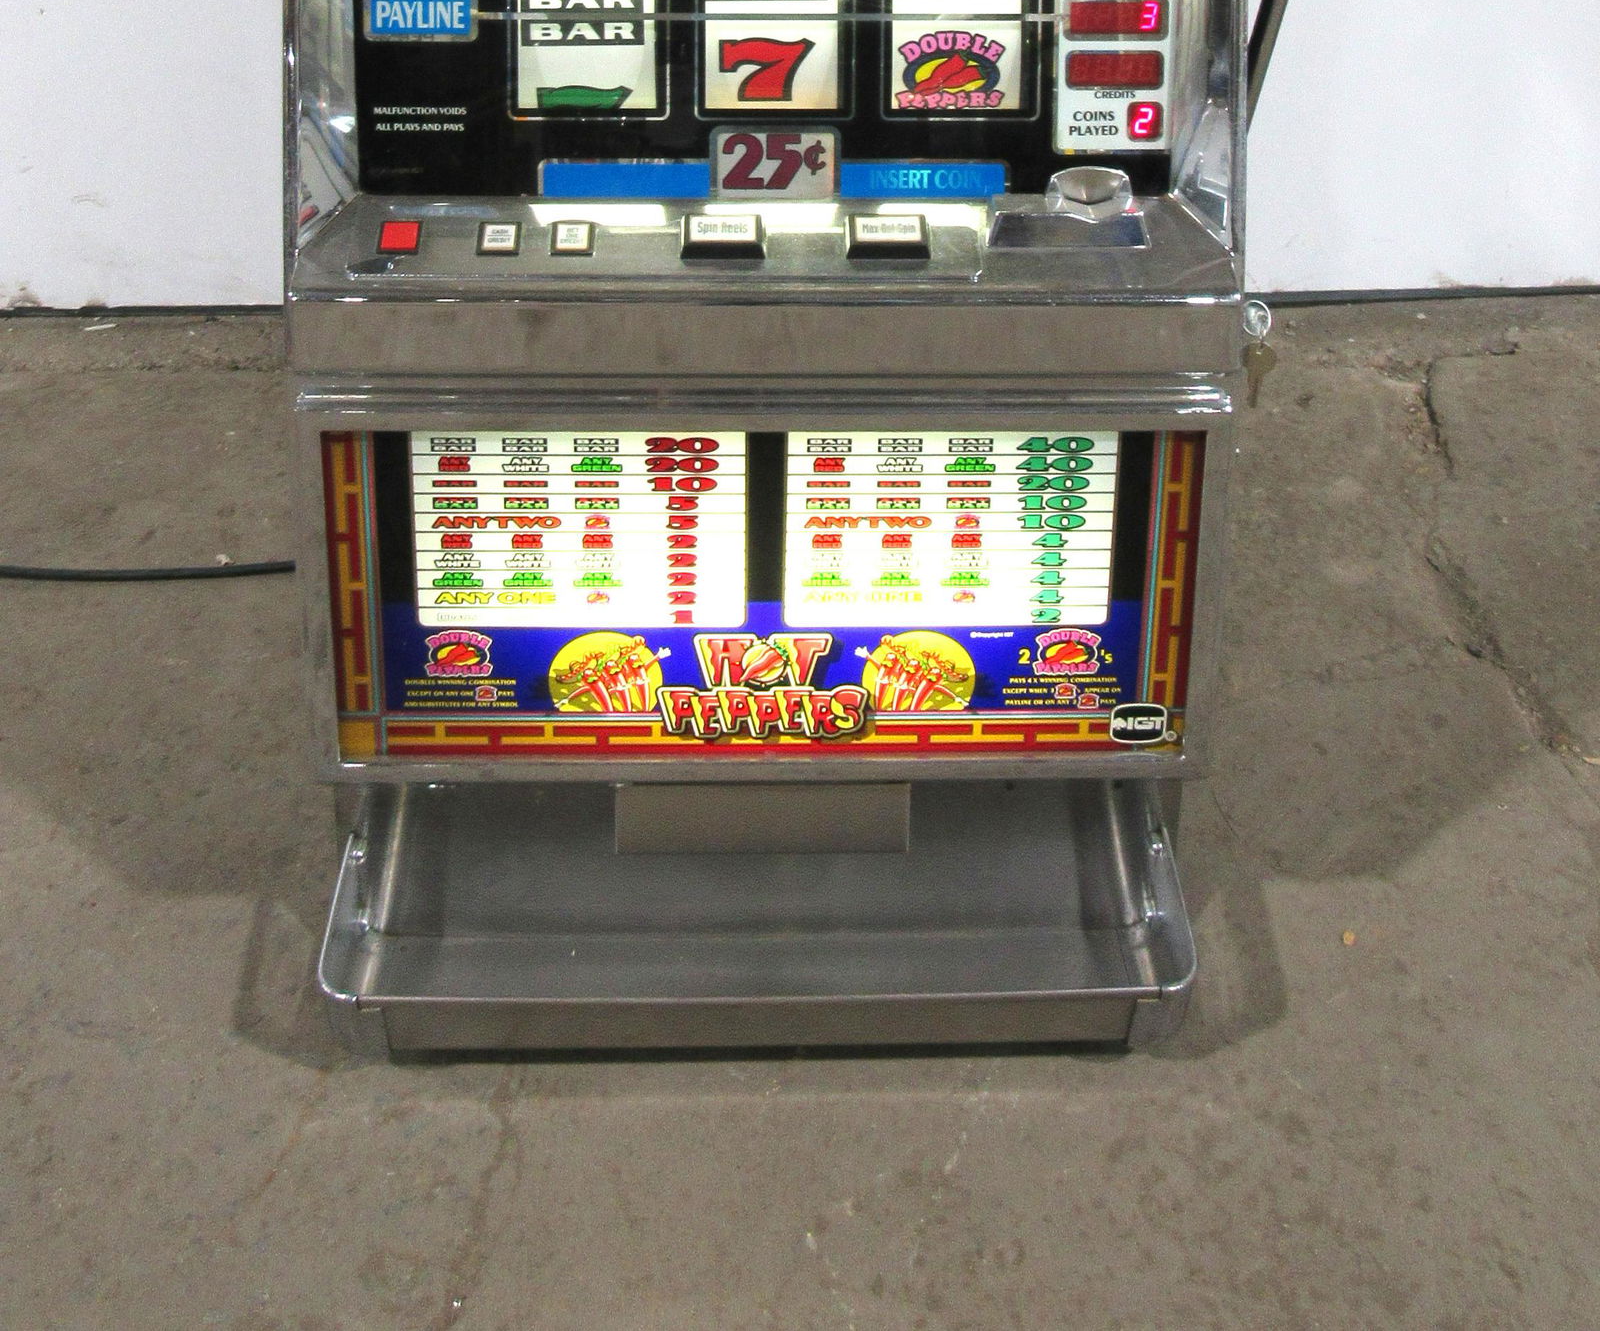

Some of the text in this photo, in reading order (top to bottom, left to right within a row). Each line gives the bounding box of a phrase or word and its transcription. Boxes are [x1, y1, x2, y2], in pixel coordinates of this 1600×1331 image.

[376, 0, 465, 29] PAYLINE
[1140, 1, 1158, 30] 3
[528, 22, 635, 41] BAR
[898, 31, 1006, 63] DOUBLE
[718, 37, 816, 101] 7
[895, 90, 1006, 109] PEPPERS
[1094, 90, 1136, 99] CREDITS
[373, 107, 467, 115] MALFUNCTION VOIDS
[1073, 111, 1115, 122] COINS
[376, 123, 464, 131] ALL PLAYS AND PAYS
[1134, 107, 1153, 134] 2
[1068, 125, 1118, 137] PLAYED
[722, 134, 827, 190] 25¢
[870, 170, 983, 189] INSERT COIN
[697, 221, 748, 234] Spin Reels
[644, 437, 720, 454] 20
[1016, 436, 1095, 453] 40
[644, 457, 720, 473] 20
[1015, 456, 1094, 472] 40
[647, 476, 718, 492] 10
[1017, 475, 1090, 491] 20
[666, 496, 699, 511] 5
[1017, 495, 1087, 510] 10
[432, 516, 562, 529] ANY TWO
[666, 515, 699, 530] 5
[804, 516, 932, 529] ANY TWO
[1017, 513, 1086, 529] 10
[667, 534, 698, 549] 2
[1031, 532, 1068, 548] 4
[667, 553, 698, 568] 2
[1031, 551, 1067, 566] 4
[667, 572, 698, 587] 2
[1029, 570, 1066, 585] 4
[435, 591, 556, 605] ANY ONE
[667, 591, 698, 605] 2
[1028, 589, 1064, 604] 4
[670, 610, 694, 624] 1
[1031, 608, 1061, 623] 2
[1038, 629, 1102, 647] DOUBLE
[694, 633, 833, 687] HOT
[1018, 649, 1031, 664] 2
[657, 685, 868, 738] PEPPERS
[1128, 717, 1165, 730] IGT
